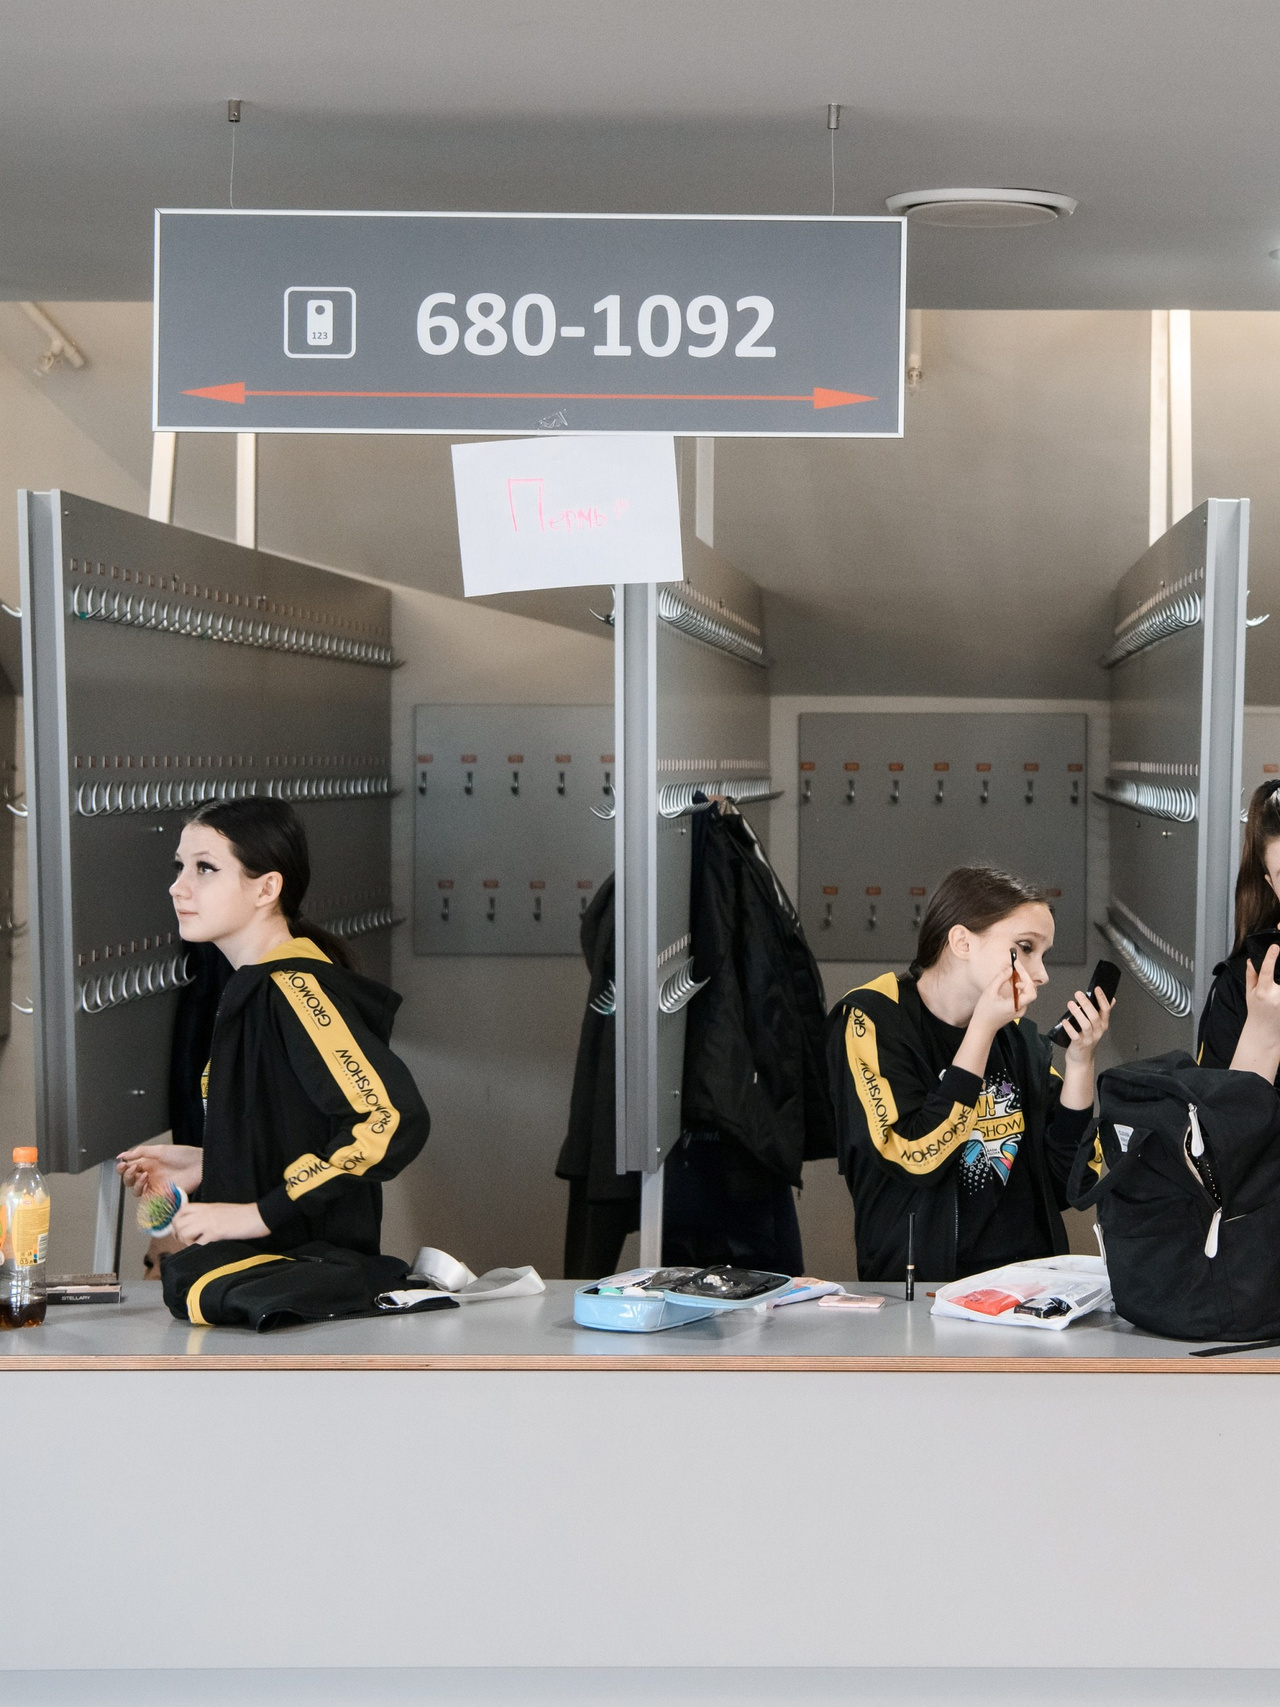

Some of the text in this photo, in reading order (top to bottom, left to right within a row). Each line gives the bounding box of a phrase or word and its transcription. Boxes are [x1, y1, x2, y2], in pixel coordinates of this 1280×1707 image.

[311, 331, 329, 340] 123
[416, 291, 777, 358] 680-1092
[283, 970, 332, 1027] GROMOV
